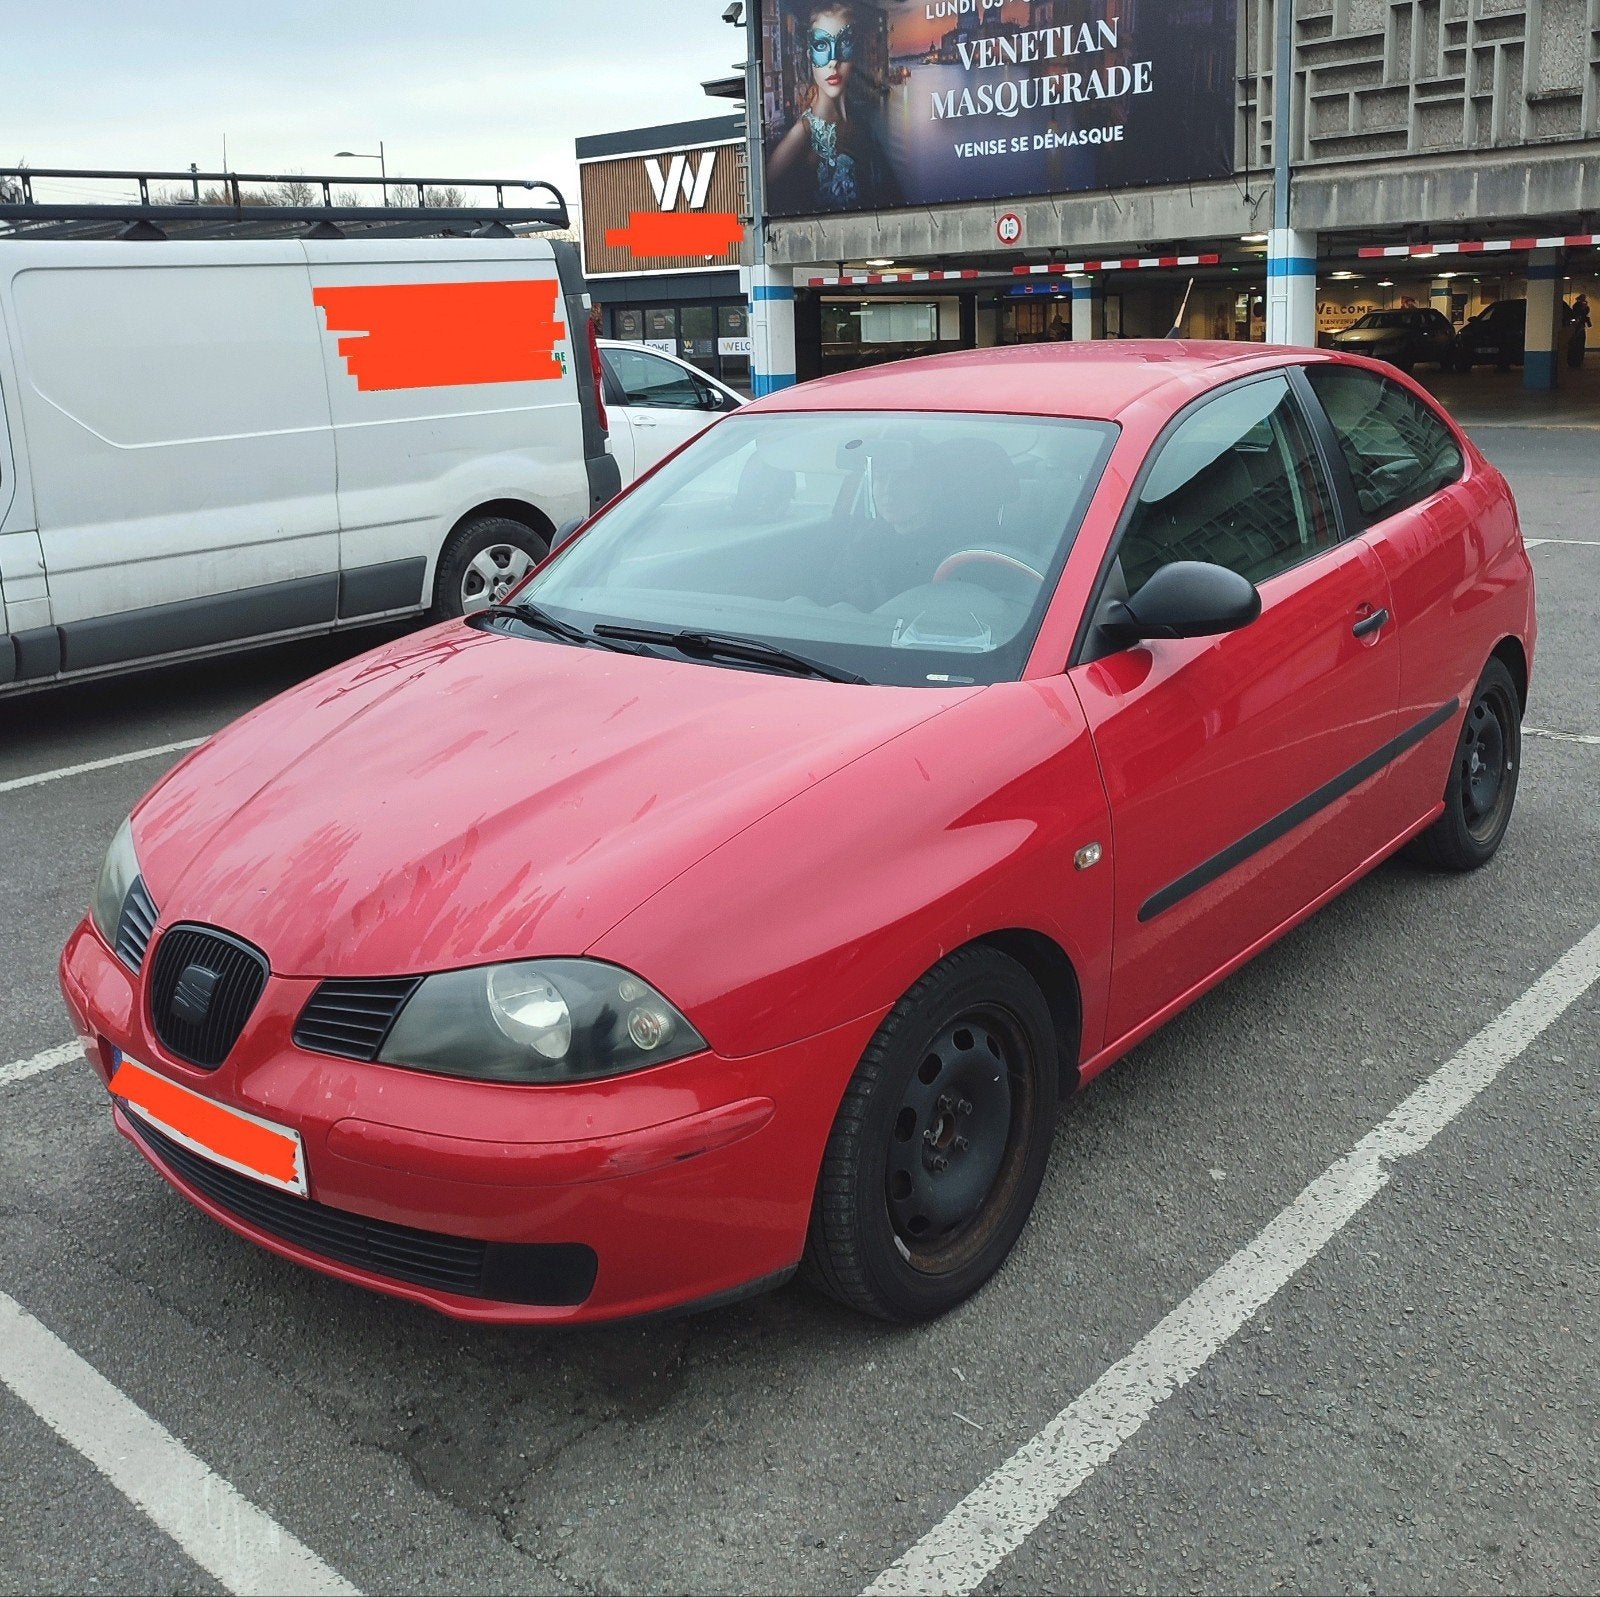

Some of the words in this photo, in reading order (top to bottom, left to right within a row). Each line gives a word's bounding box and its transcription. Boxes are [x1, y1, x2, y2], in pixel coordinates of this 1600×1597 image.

[926, 0, 976, 19] LUNDI
[956, 16, 1120, 71] VENETIAN
[930, 60, 1154, 121] MASQUERADE
[954, 138, 1007, 158] VENISE
[1010, 136, 1029, 153] SE
[1033, 125, 1124, 150] DÉMASQUE
[644, 151, 716, 212] W
